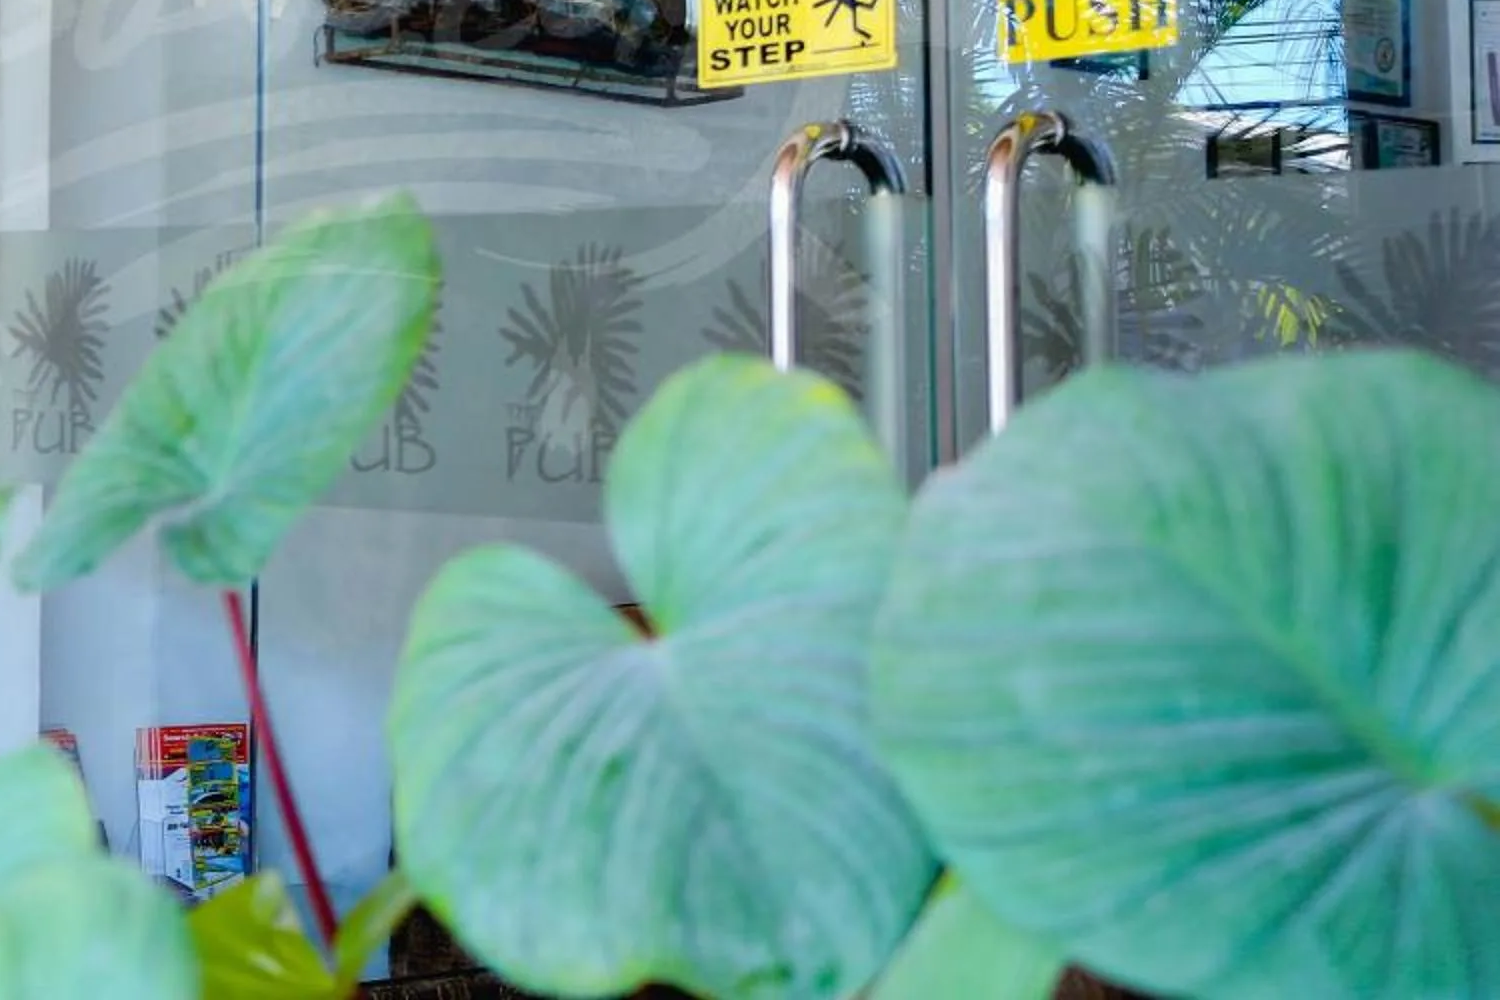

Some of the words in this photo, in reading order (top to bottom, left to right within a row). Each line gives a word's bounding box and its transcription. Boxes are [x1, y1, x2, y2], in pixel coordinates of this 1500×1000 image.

[725, 13, 791, 41] YOUR
[710, 40, 805, 71] STEP
[349, 424, 437, 475] UB
